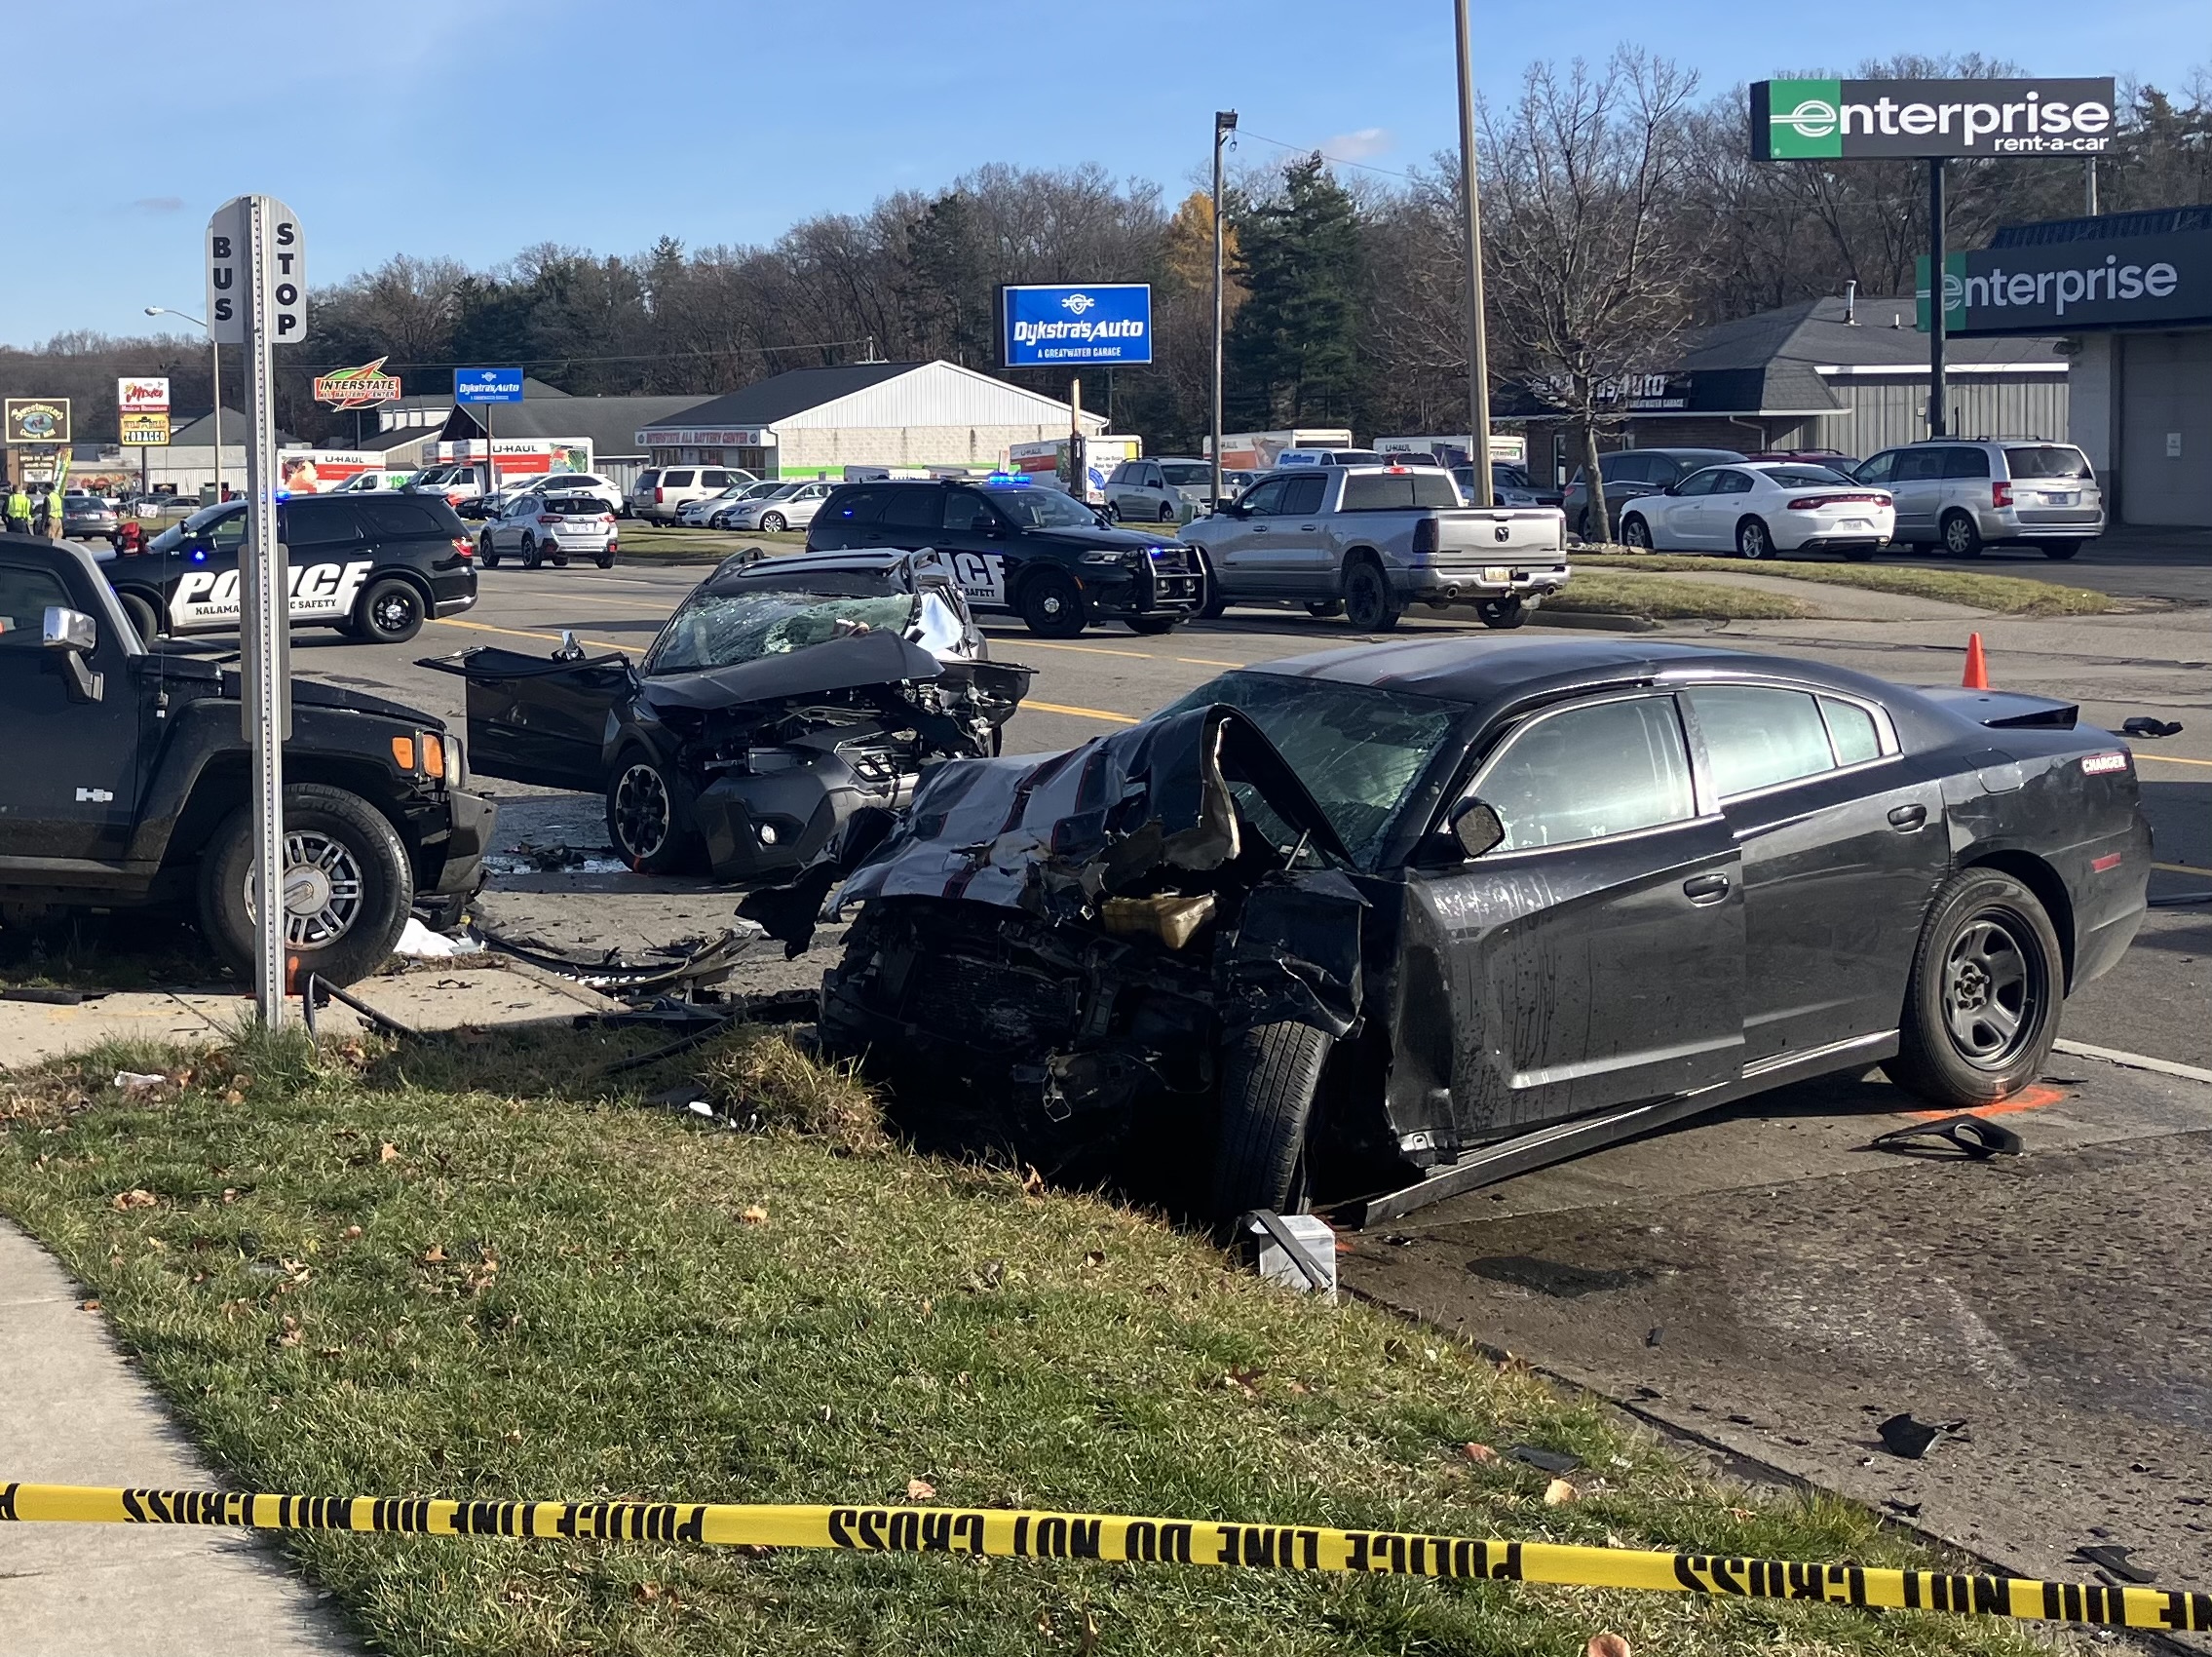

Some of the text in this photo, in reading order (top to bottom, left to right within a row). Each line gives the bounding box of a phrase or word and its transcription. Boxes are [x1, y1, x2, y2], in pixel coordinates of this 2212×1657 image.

[1771, 91, 2111, 145] enterprise
[1994, 135, 2110, 151] rent-a-car
[212, 237, 233, 322] BUS
[276, 223, 298, 335] STOP
[1941, 254, 2178, 316] enterprise
[1037, 347, 1122, 359] A GREATWATER GARAGE
[320, 380, 395, 390] INTERSTATE
[125, 431, 167, 442] TOBACCO
[298, 598, 337, 609] SAFETY
[966, 588, 995, 597] SAFETY
[123, 1488, 254, 1526] CROSS
[557, 1502, 706, 1543] POLICE
[828, 1509, 1522, 1581] POLICE LINE DO NOT CROSS
[1674, 1554, 1867, 1609] CROSS
